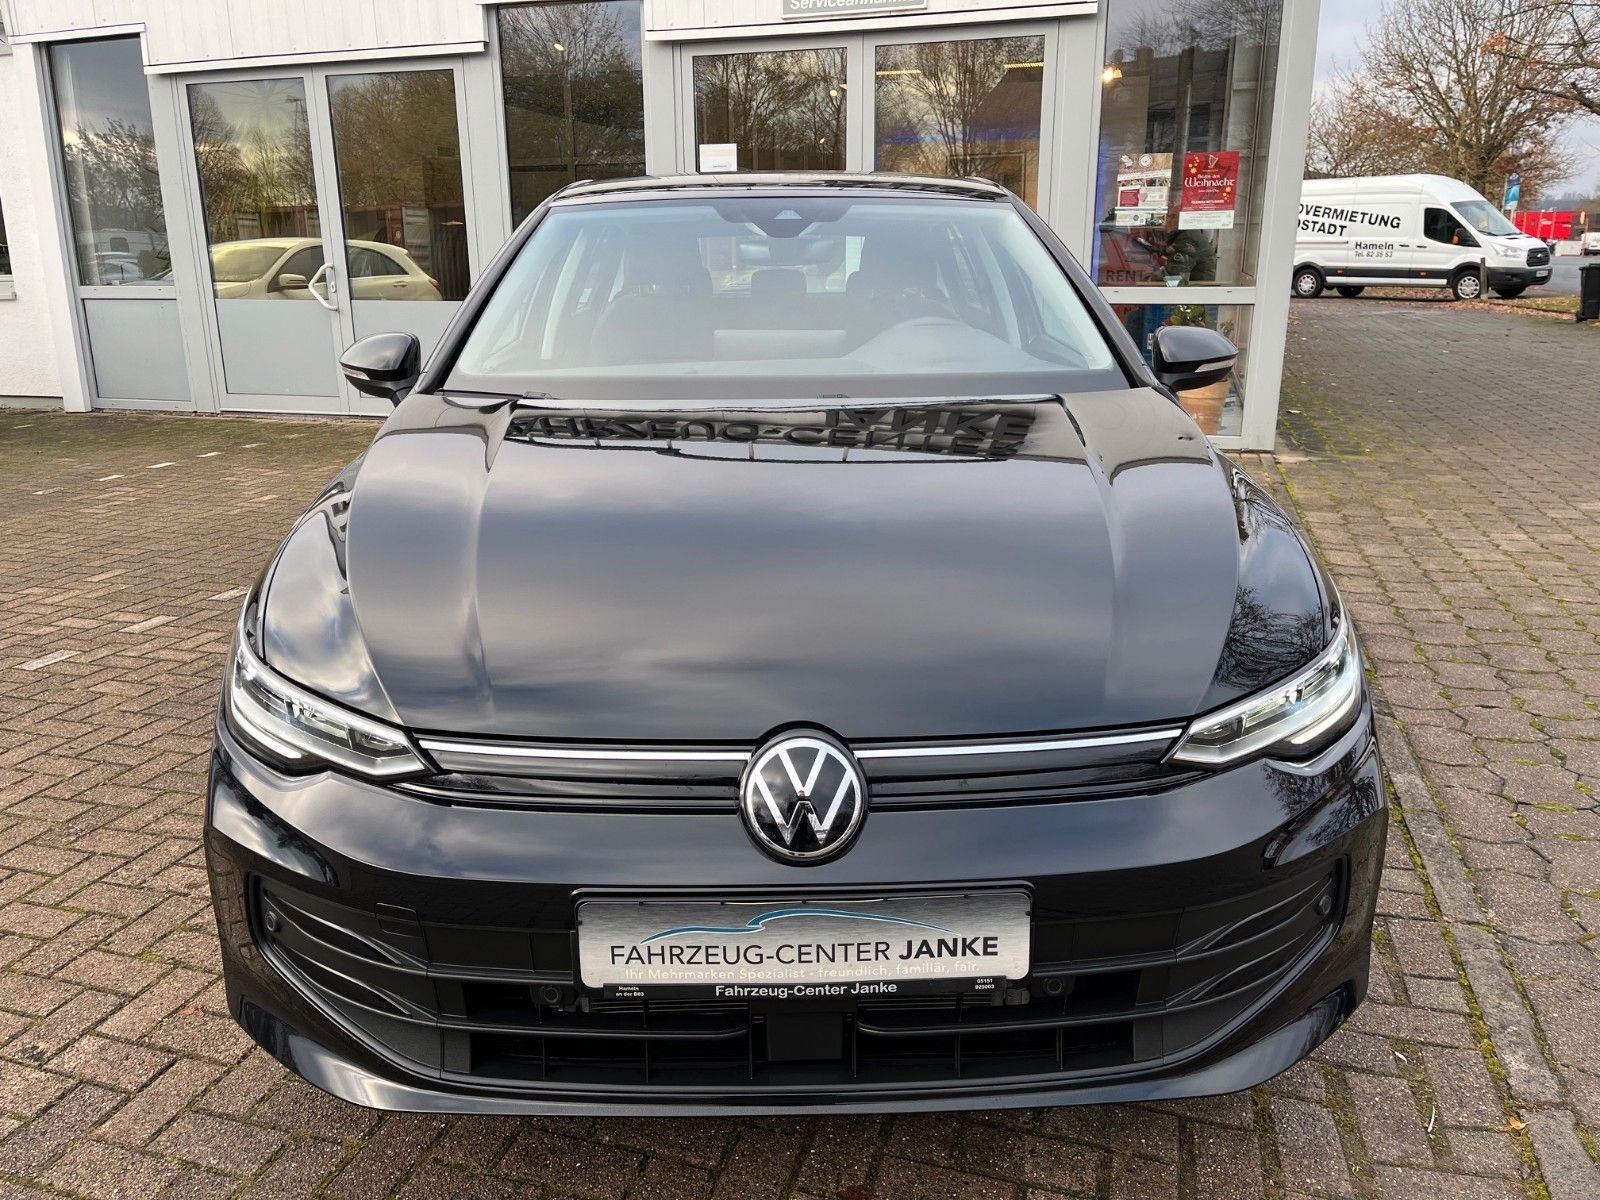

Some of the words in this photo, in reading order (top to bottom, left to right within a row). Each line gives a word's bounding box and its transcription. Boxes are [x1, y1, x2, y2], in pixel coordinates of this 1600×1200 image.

[789, 0, 914, 10] Serviceann
[1184, 177, 1235, 187] Weihnacht
[1298, 219, 1347, 236] STADT
[1355, 241, 1394, 250] Hameln
[609, 941, 891, 965] FAHRZEUG-CENTER
[899, 936, 999, 960] JANKE
[624, 968, 643, 979] Ihr
[648, 968, 735, 979] Mehrmarken
[739, 967, 805, 982] Spezialist
[818, 964, 892, 978] freundlich,
[896, 962, 950, 975] familiär,
[954, 960, 980, 972] fair.
[715, 983, 847, 999] Fahrzeug-Center
[850, 981, 898, 994] Janke
